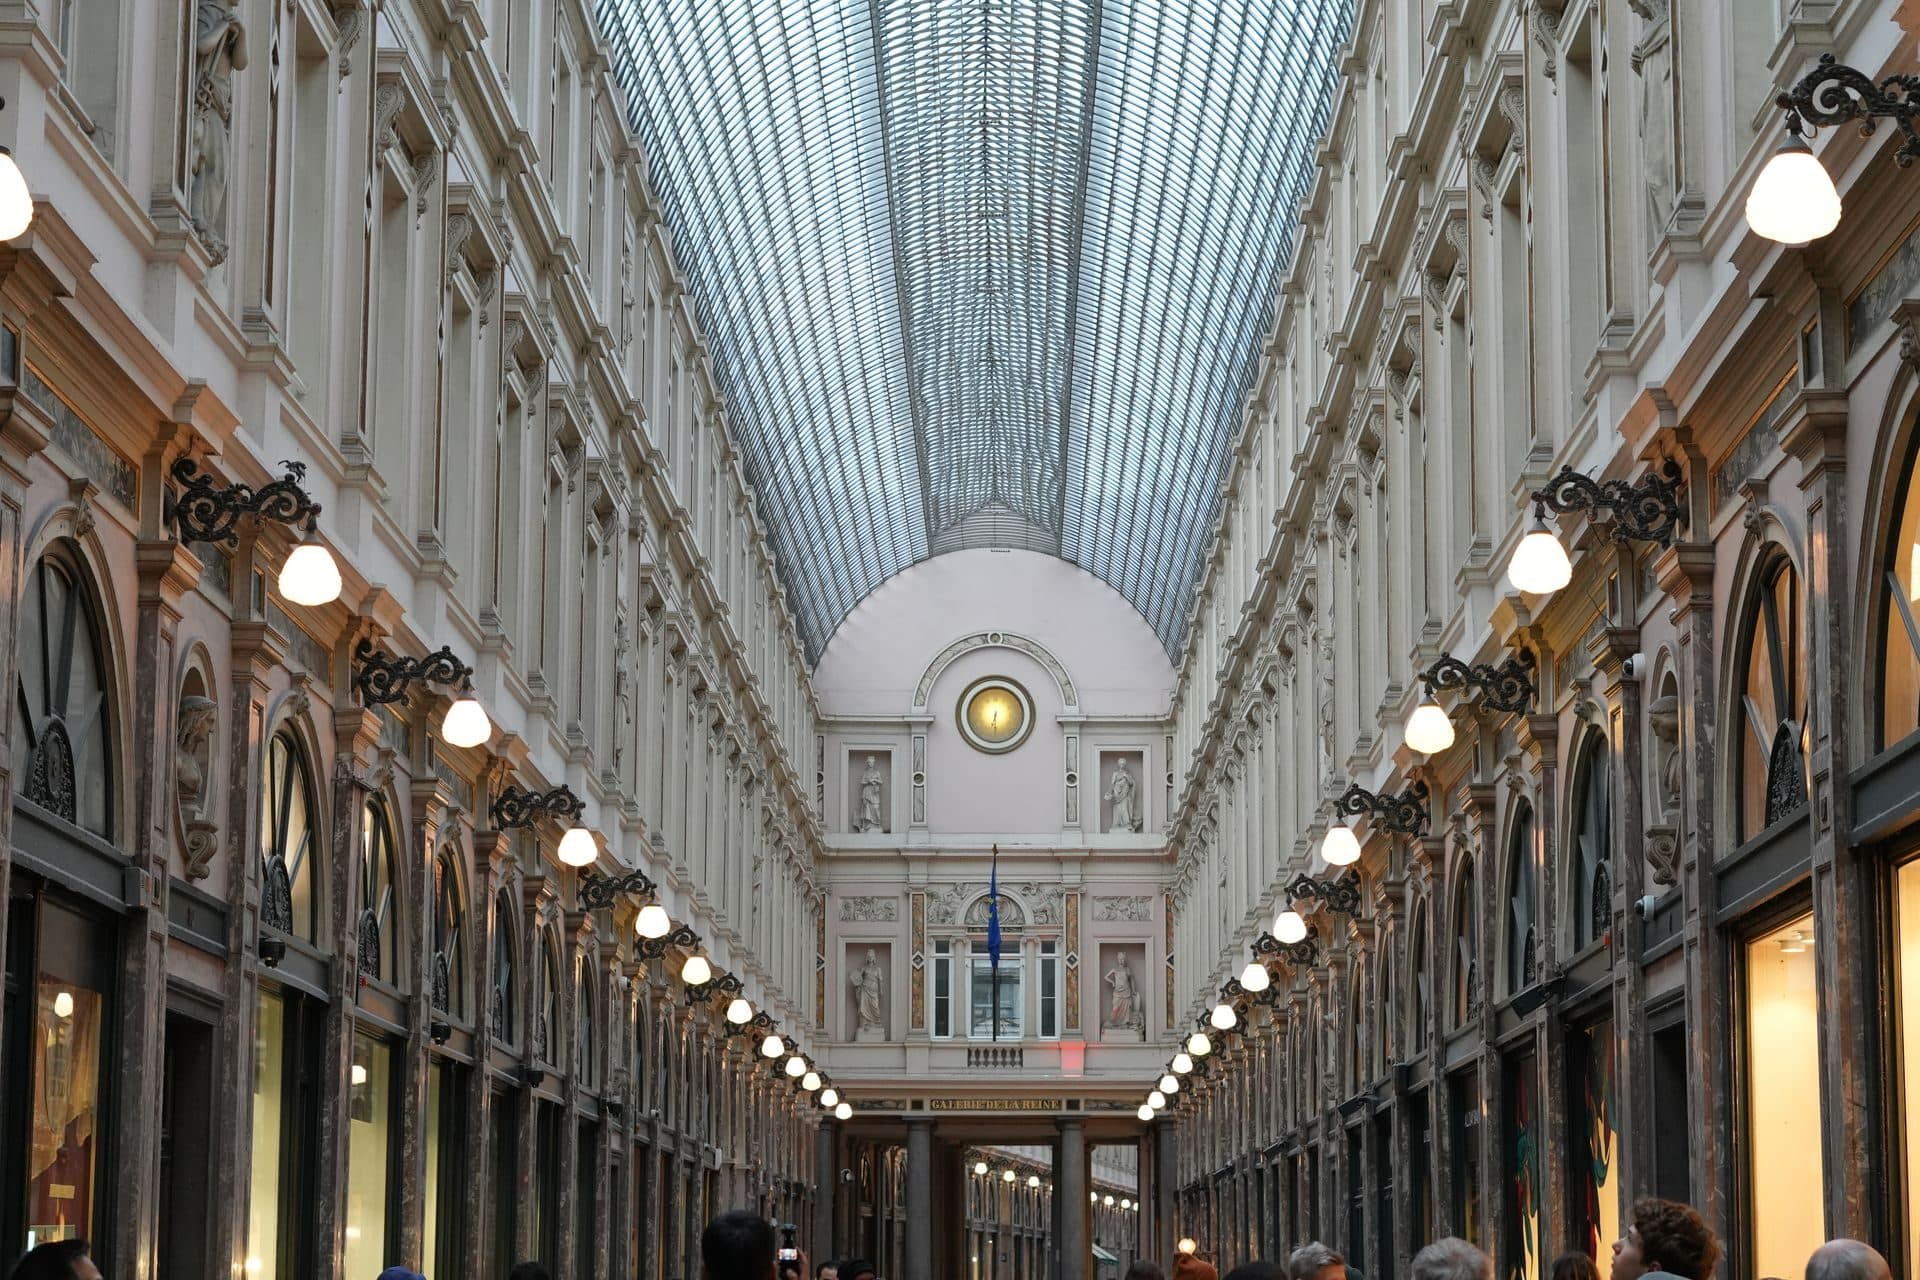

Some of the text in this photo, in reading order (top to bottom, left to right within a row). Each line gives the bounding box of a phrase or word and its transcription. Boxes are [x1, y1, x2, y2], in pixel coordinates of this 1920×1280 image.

[932, 1099, 1059, 1109] GALERIE DE LA REINE
